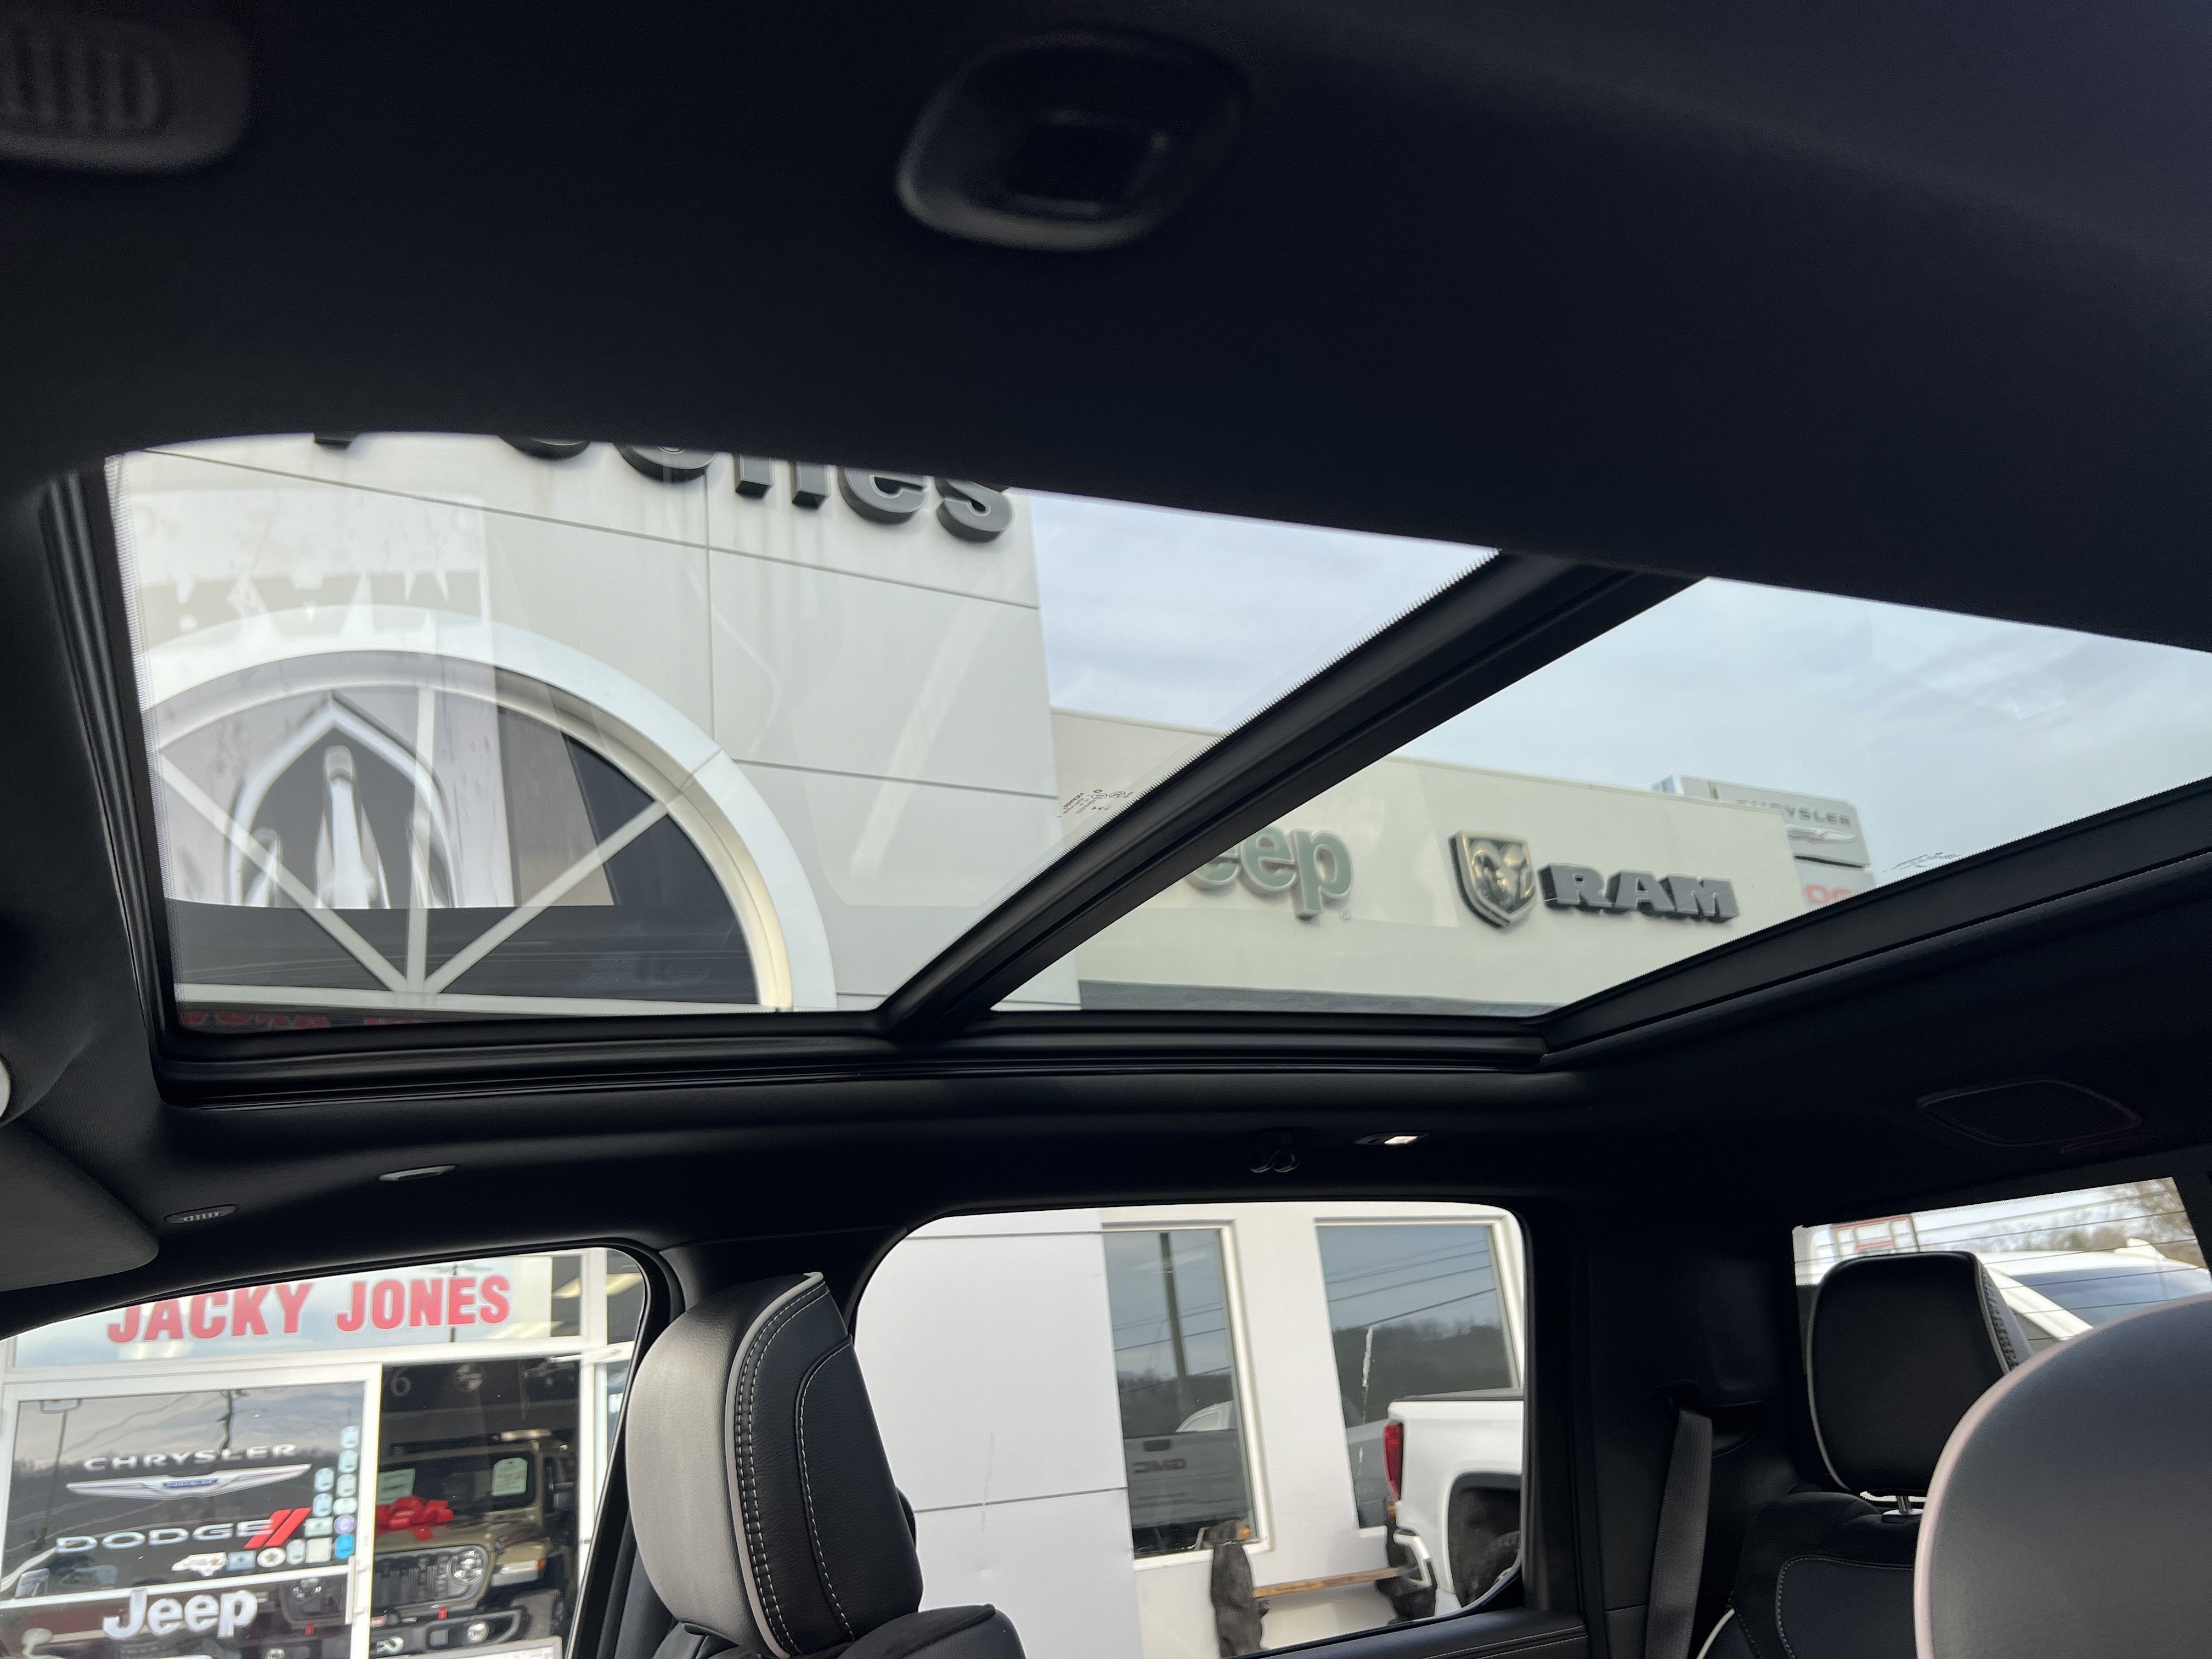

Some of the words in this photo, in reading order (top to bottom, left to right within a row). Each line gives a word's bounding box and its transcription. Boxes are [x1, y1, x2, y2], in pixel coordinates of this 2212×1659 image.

[1538, 862, 1739, 919] RAM
[107, 1282, 314, 1344] JACKY
[335, 1276, 511, 1333] JONES
[84, 1444, 297, 1471] CHRYSLER
[57, 1519, 274, 1554] DODGE
[103, 1588, 257, 1639] Jeep
